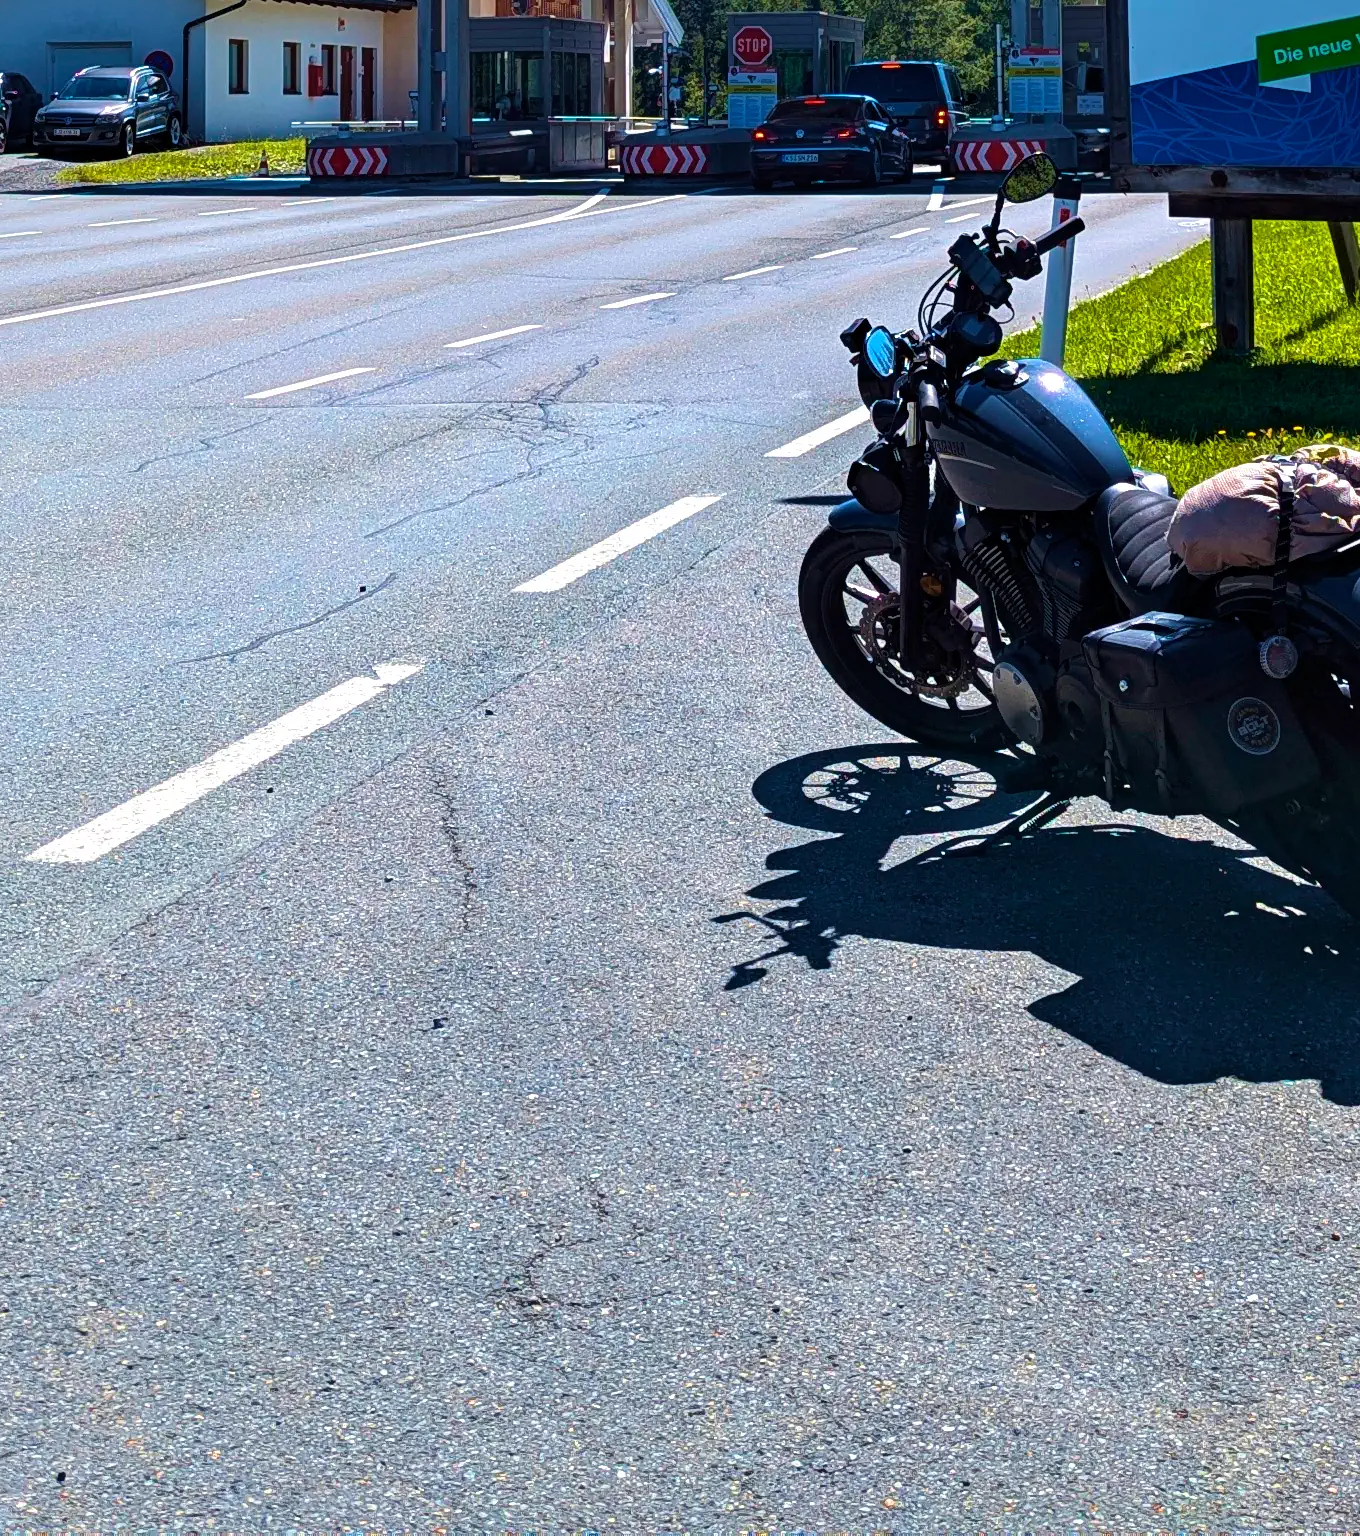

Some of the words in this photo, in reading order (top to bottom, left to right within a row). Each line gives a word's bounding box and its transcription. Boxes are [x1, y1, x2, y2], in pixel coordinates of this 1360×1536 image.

[737, 38, 768, 53] STOP
[1273, 47, 1304, 65] Die
[1308, 38, 1352, 58] neue
